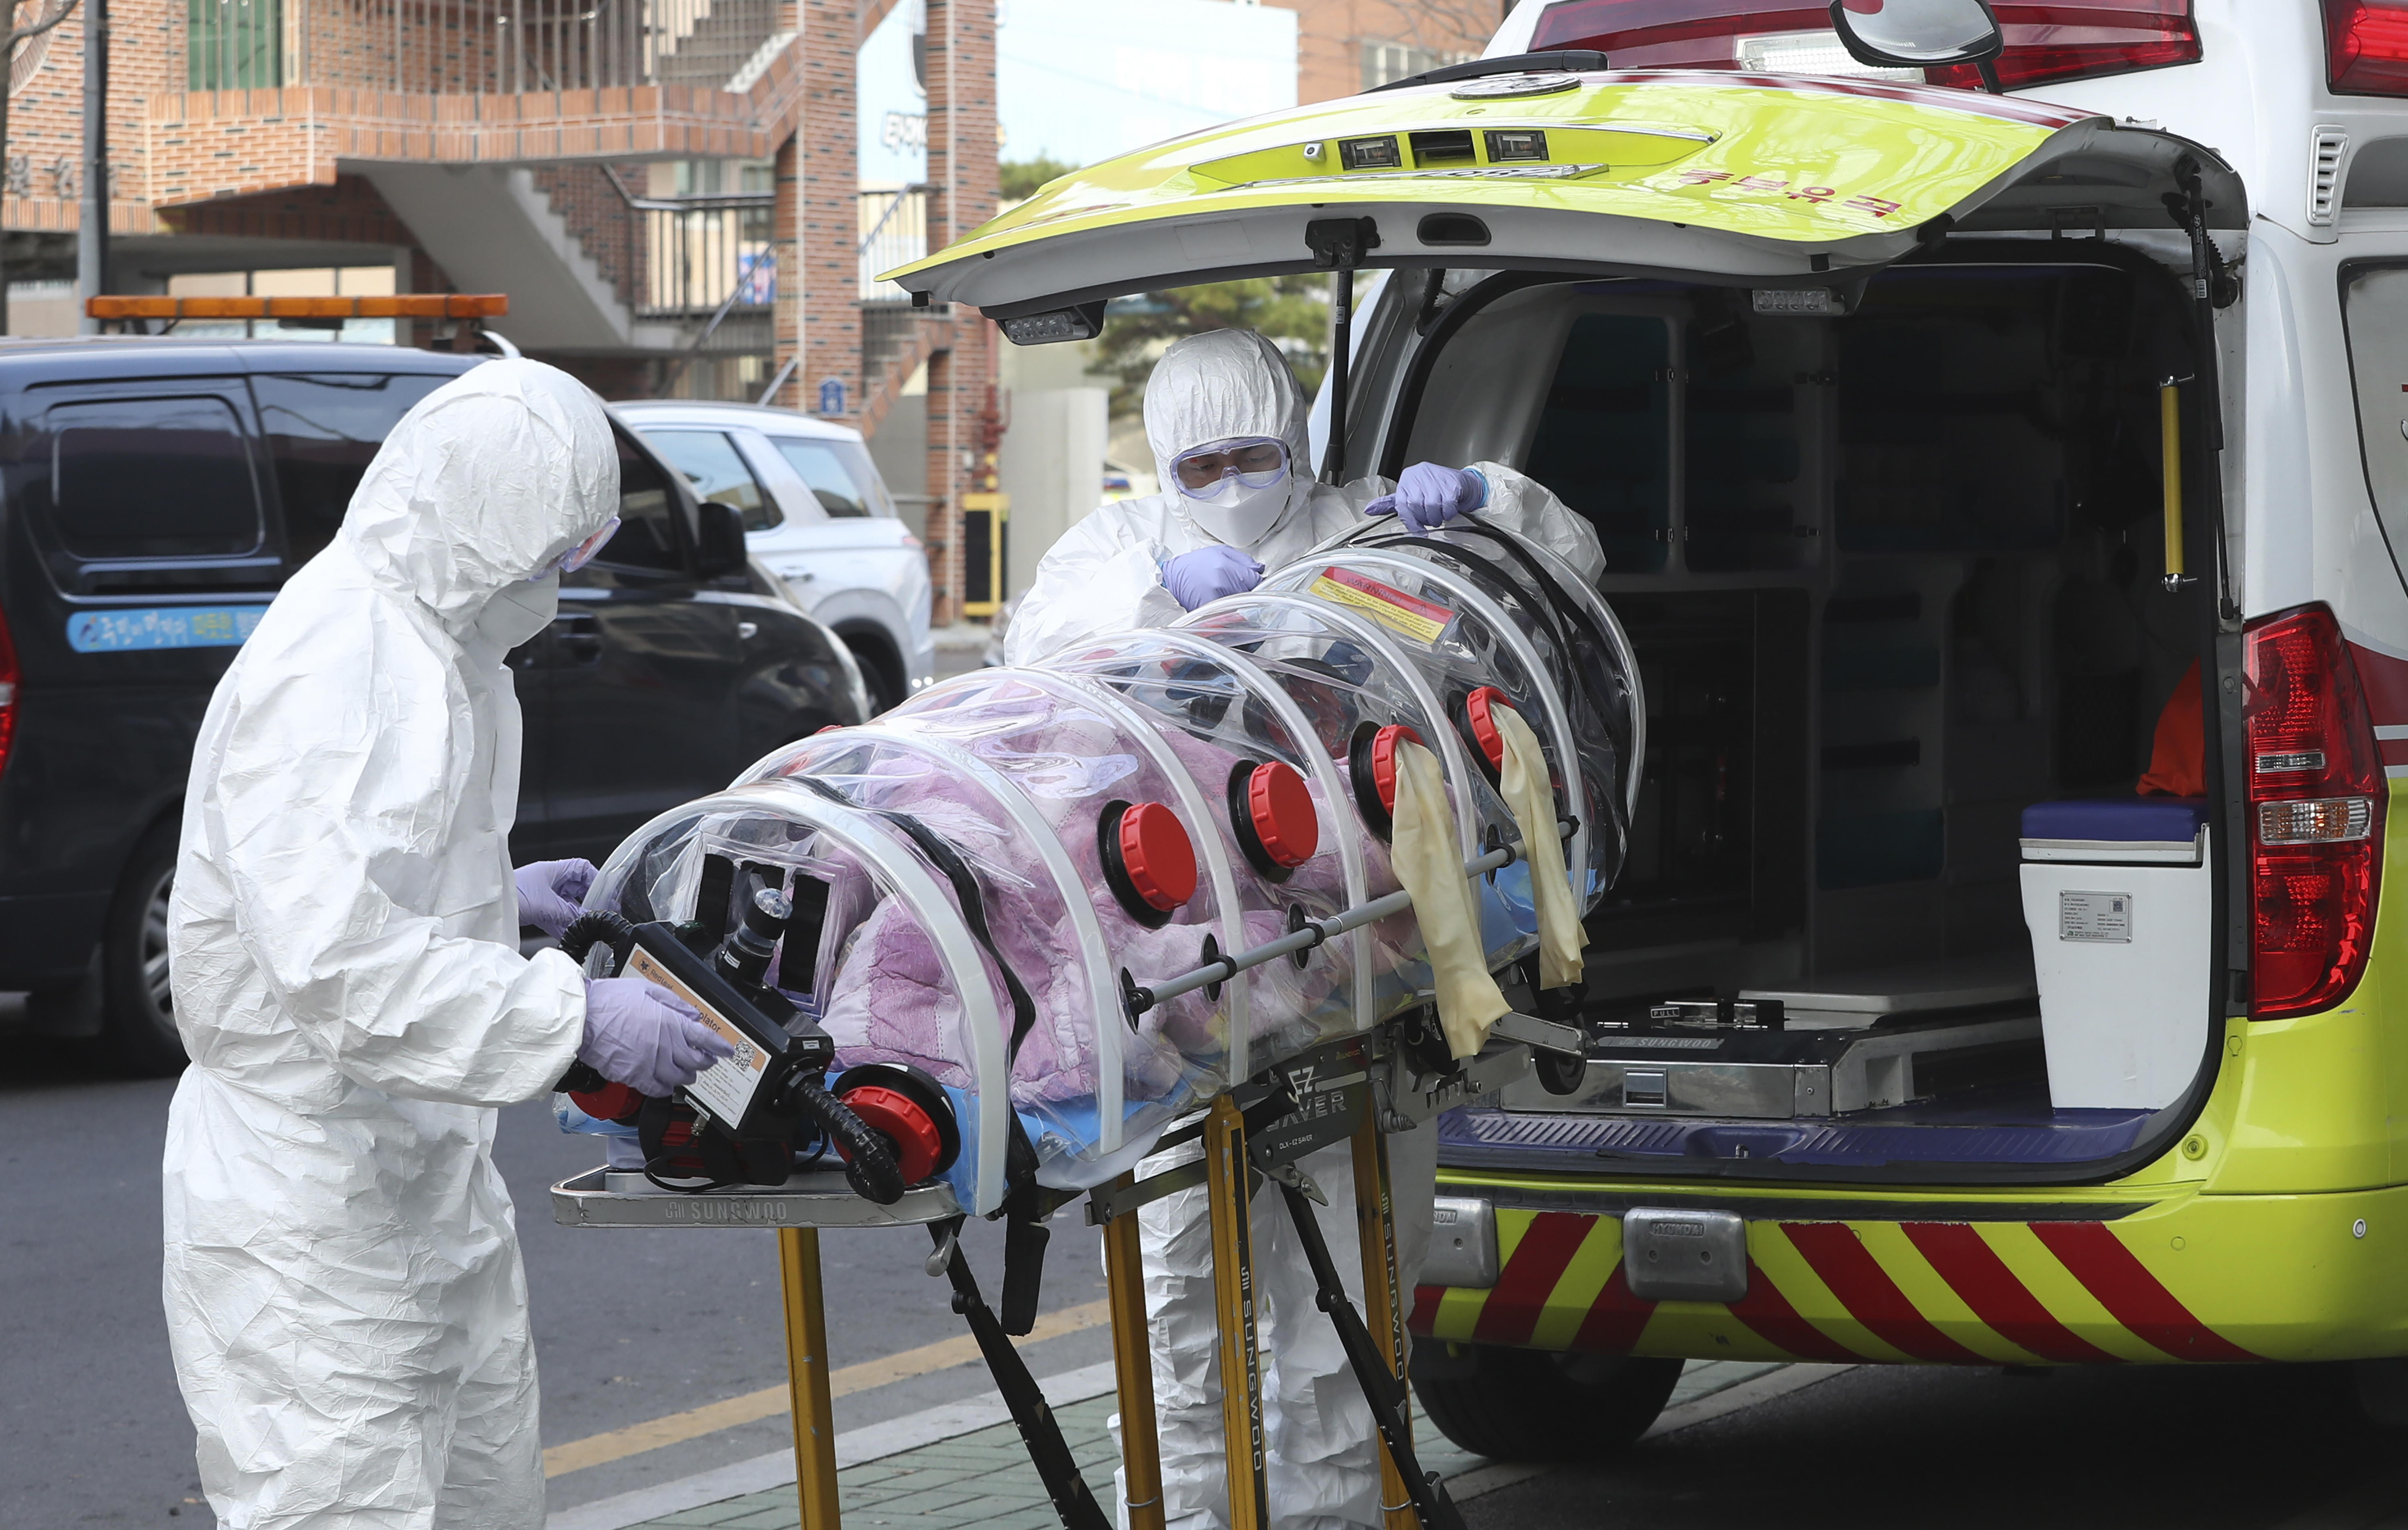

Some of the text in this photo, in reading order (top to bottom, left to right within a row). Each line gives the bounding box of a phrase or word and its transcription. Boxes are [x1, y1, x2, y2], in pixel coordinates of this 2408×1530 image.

[1346, 577, 1402, 602] WARNING!
[695, 1005, 721, 1032] olator
[1639, 1039, 1710, 1047] SUNGWOO
[1288, 1066, 1314, 1095] EZ
[691, 1202, 787, 1219] SUNGWOO
[1653, 1223, 1703, 1236] HYUNDAI
[1384, 1223, 1404, 1380] SUNGWOO
[1243, 1300, 1262, 1471] SUNGWOO
